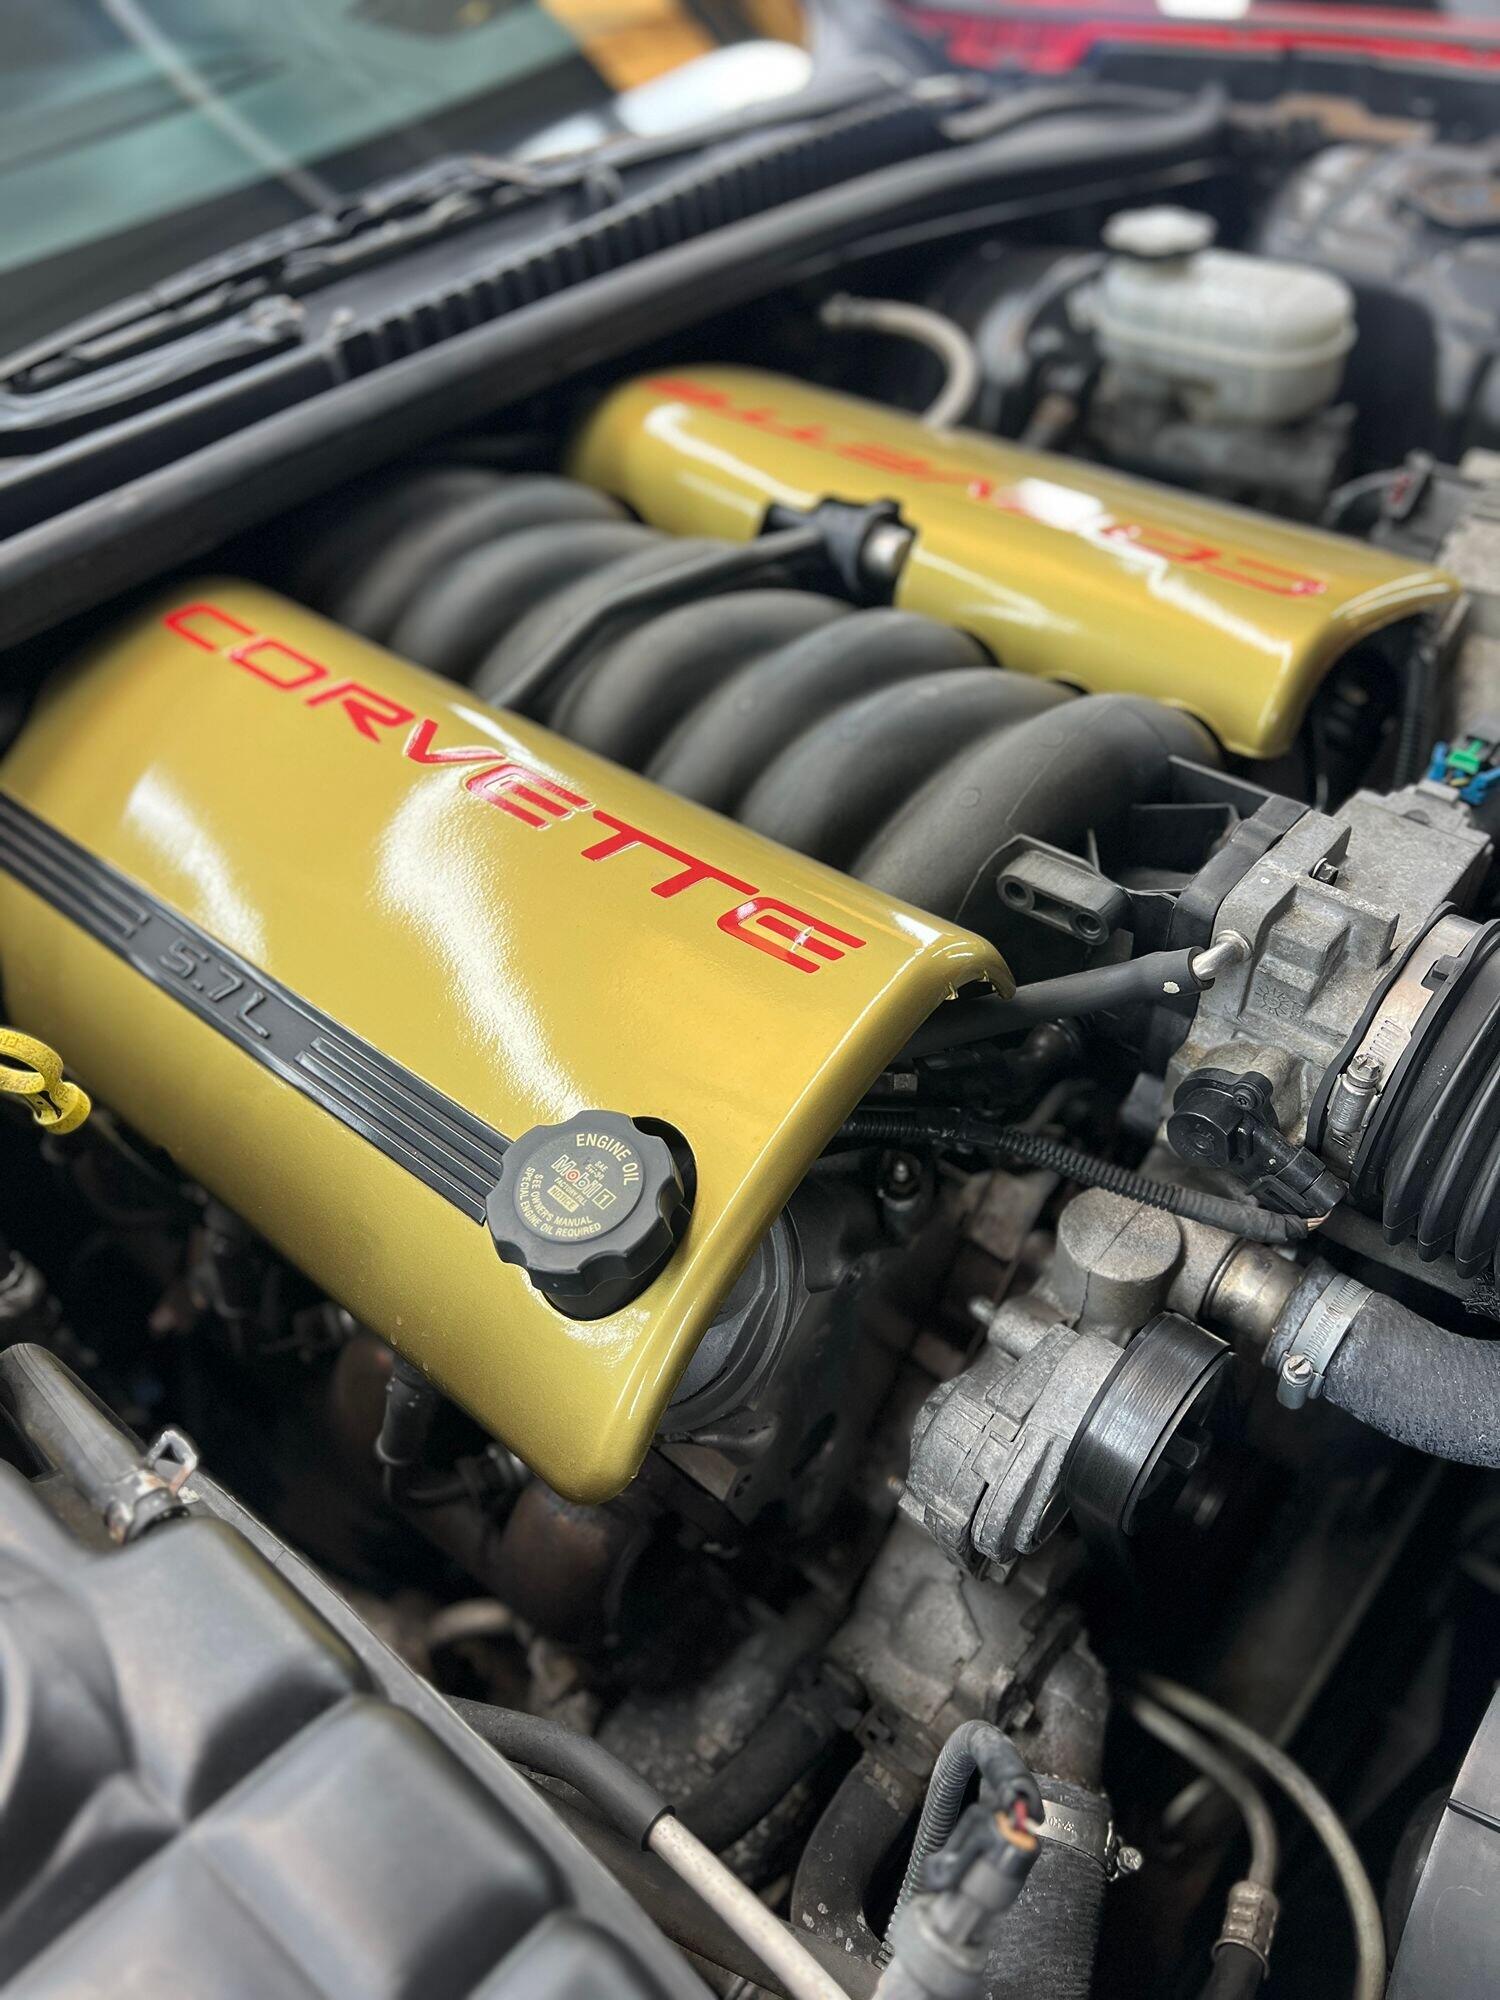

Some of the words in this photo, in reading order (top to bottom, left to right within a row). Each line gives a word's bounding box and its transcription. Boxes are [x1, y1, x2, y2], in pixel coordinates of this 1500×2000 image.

[163, 602, 867, 974] CORVETTE
[160, 938, 270, 1039] 5.7L
[576, 1133, 632, 1162] ENGINE
[622, 1162, 640, 1186] OIL
[594, 1160, 609, 1173] SAE
[519, 1166, 536, 1201] SPECIAL
[550, 1154, 603, 1199] Mobil
[554, 1177, 579, 1198] FACTORY
[575, 1194, 588, 1206] FILL
[520, 1200, 542, 1228] ENGINE
[531, 1174, 544, 1190] SEE
[554, 1216, 593, 1227] MANUAL
[549, 1186, 578, 1211] NOTICE
[540, 1223, 553, 1235] OIL
[555, 1222, 602, 1238] REQUIRED
